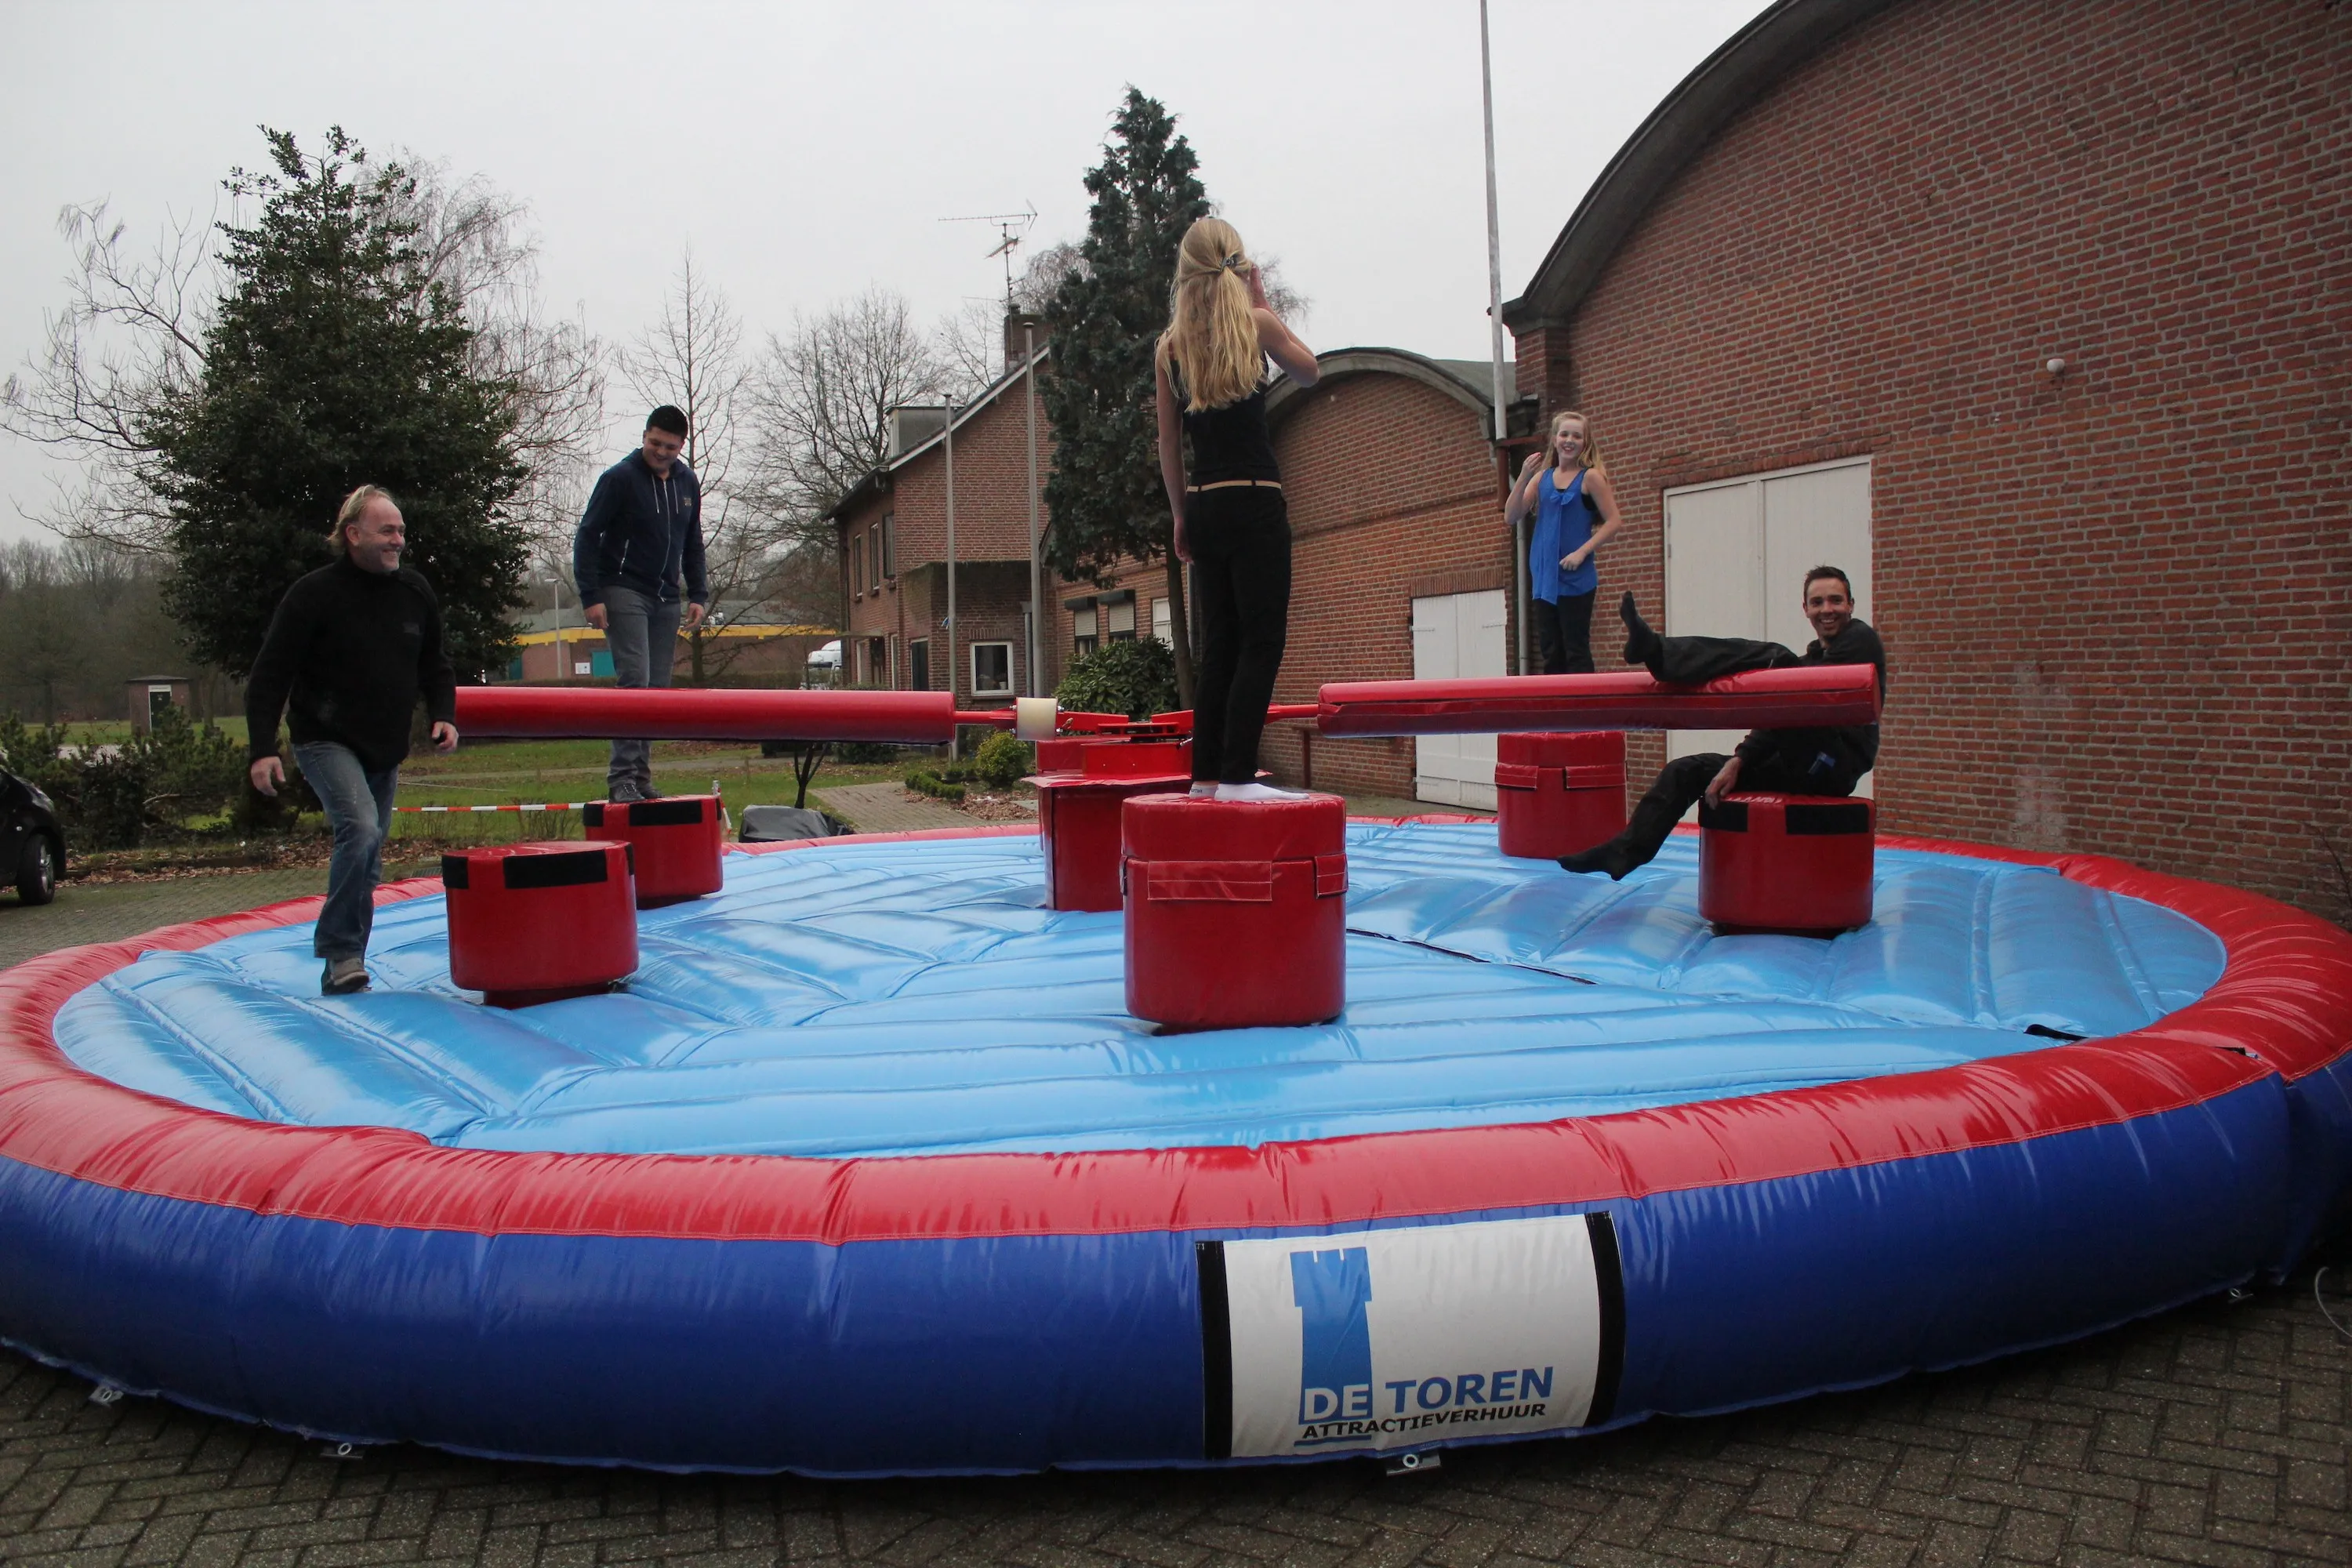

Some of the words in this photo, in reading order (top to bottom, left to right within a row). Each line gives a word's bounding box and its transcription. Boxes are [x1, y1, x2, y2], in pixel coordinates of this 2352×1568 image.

[1304, 1383, 1370, 1422] DE
[1385, 1366, 1554, 1414] TOREN
[1301, 1403, 1546, 1439] ATTRACTIEVERHUUR
